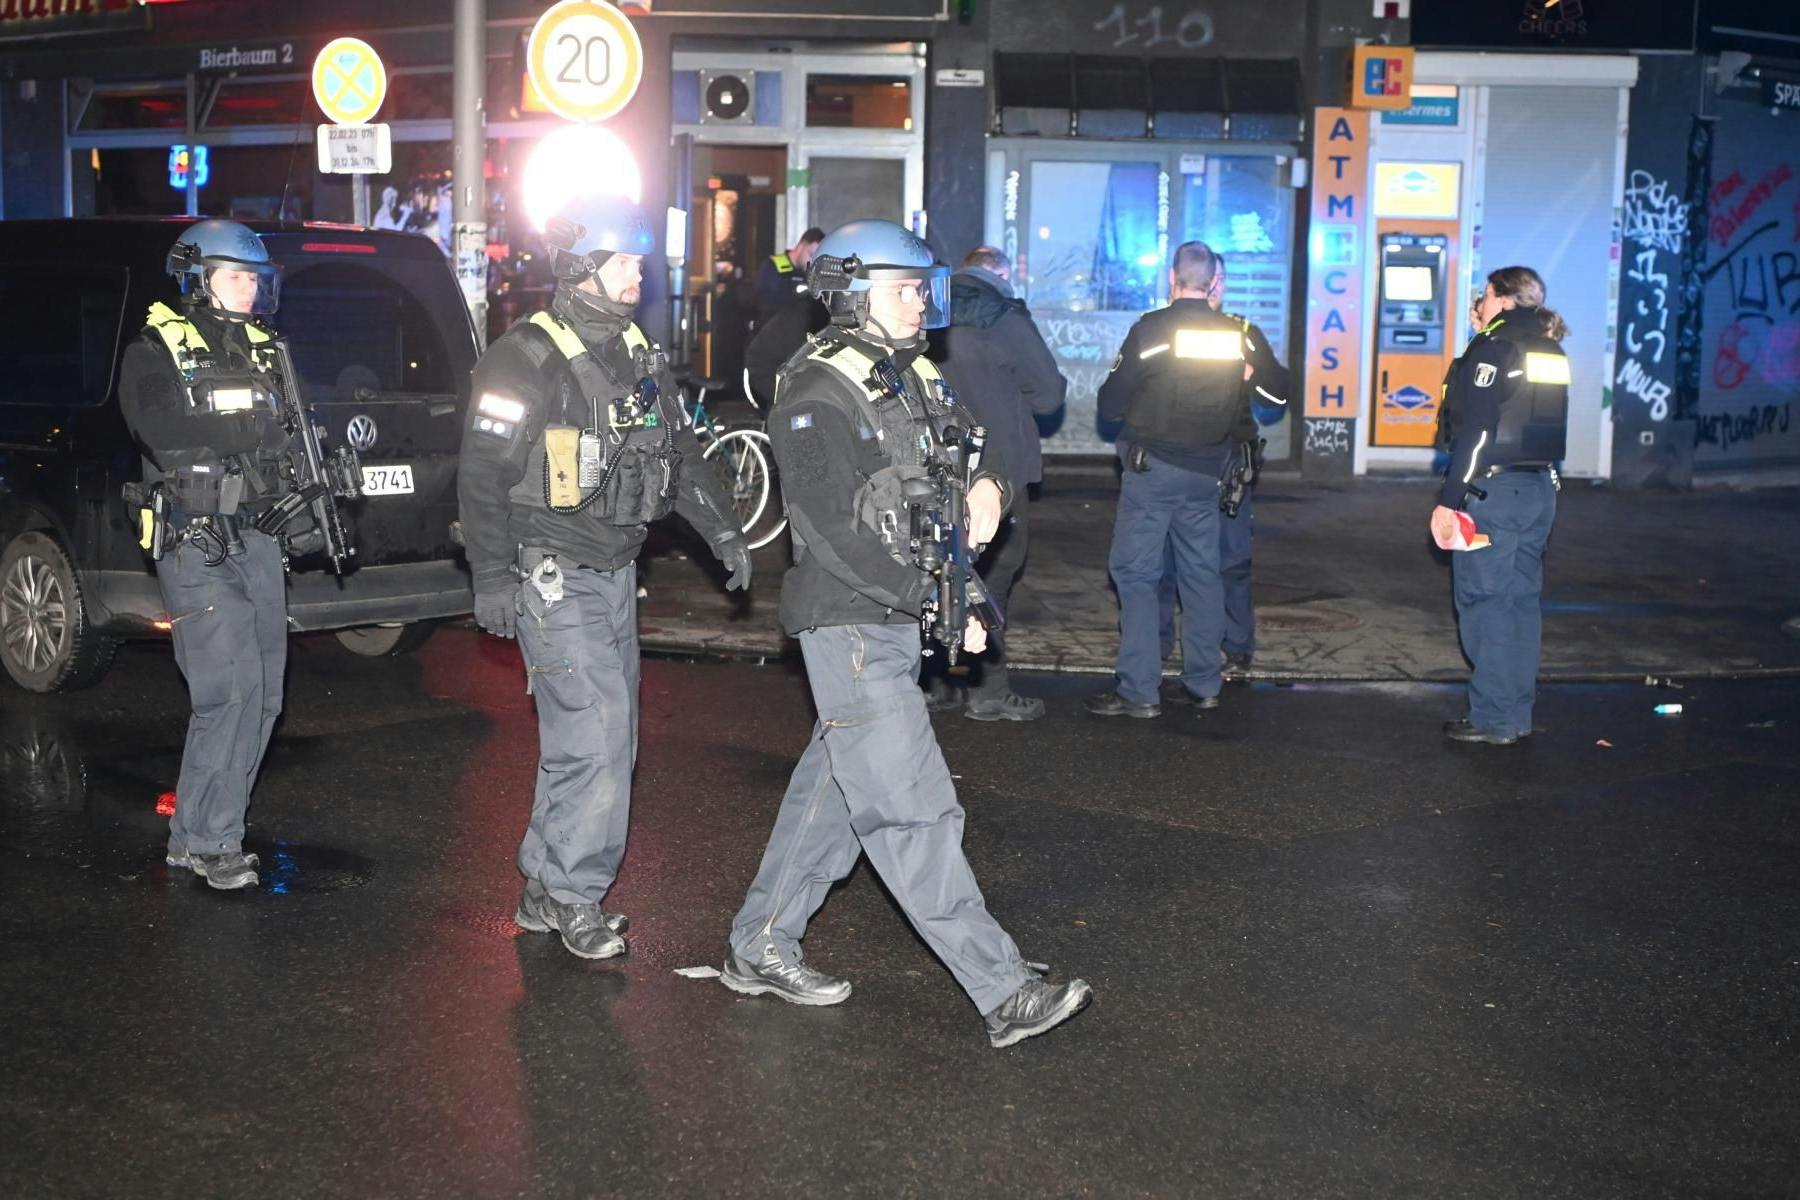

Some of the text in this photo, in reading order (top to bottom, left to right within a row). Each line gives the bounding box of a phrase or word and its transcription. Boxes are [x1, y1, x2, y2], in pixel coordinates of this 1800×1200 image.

[200, 43, 294, 68] Bierbaum 2
[557, 34, 610, 86] 20
[1328, 117, 1354, 217] ATM
[1320, 271, 1348, 408] CASH
[644, 412, 657, 427] 32
[367, 469, 412, 491] 3741
